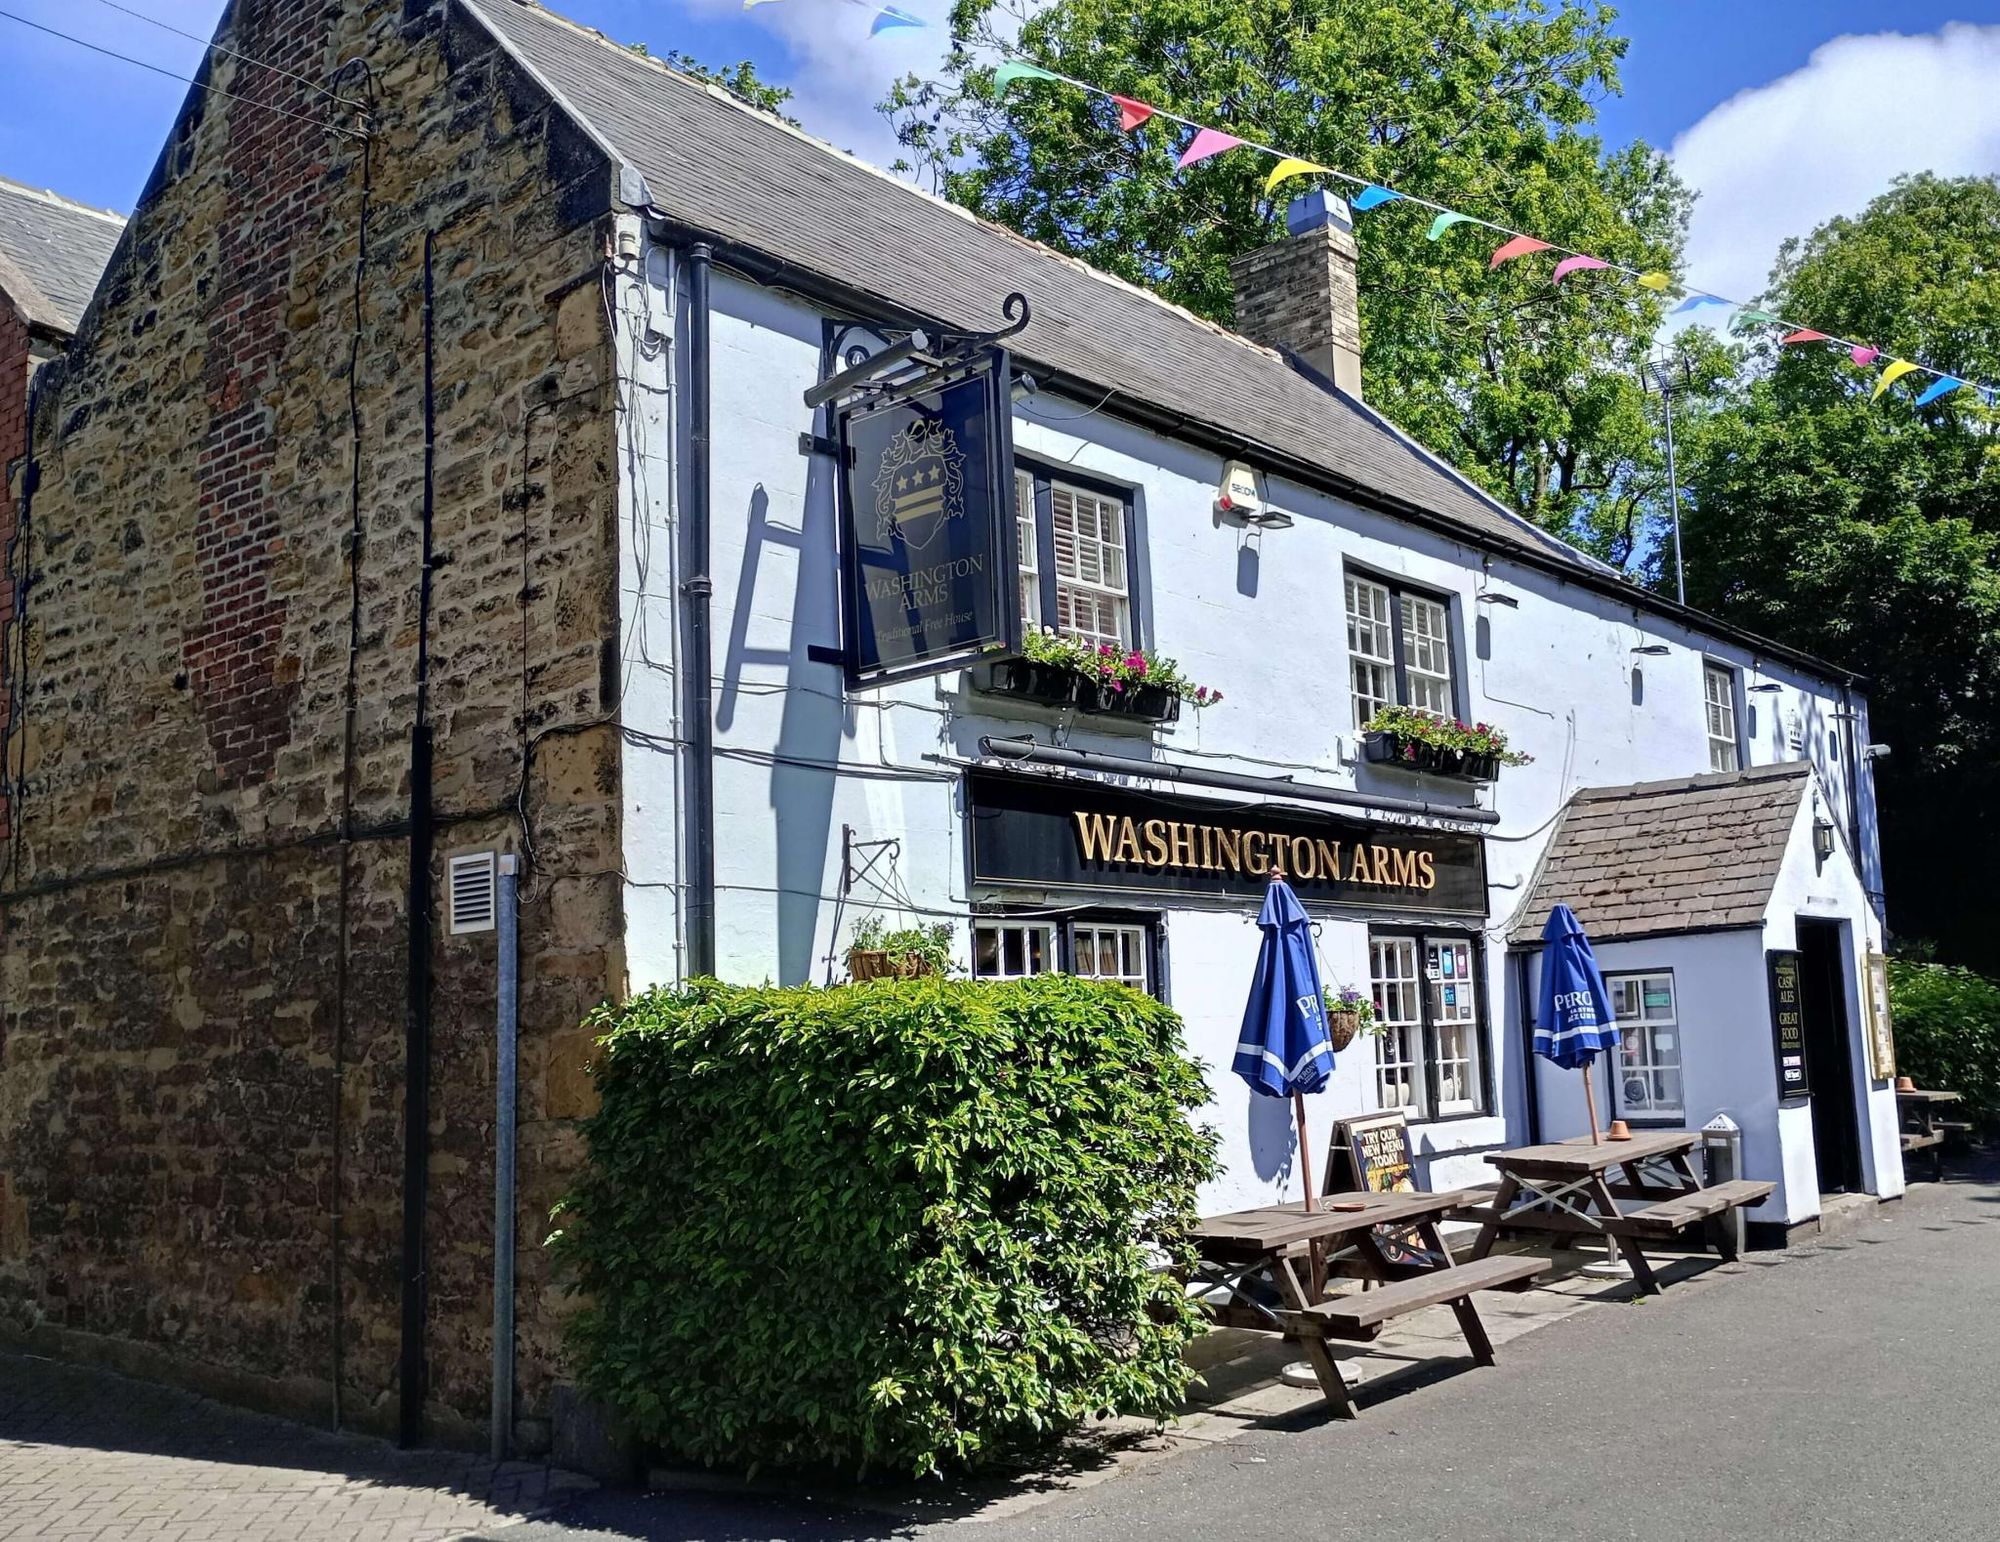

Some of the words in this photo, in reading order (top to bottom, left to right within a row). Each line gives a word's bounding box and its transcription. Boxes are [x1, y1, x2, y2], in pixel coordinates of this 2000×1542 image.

[864, 554, 983, 600] WASHINGTON
[899, 584, 948, 613] ARMS
[877, 621, 923, 641] Traditional
[924, 618, 944, 633] Free
[944, 611, 973, 627] House
[1072, 811, 1341, 881] WASHINGTON
[1349, 843, 1436, 890] ARMS
[1777, 976, 1794, 989] CASK
[1780, 990, 1795, 1003] ALES
[1779, 1012, 1798, 1025] GREAT
[1781, 1027, 1799, 1040] FOOD
[1363, 1131, 1379, 1145] TRY
[1380, 1128, 1398, 1141] OUR
[1361, 1143, 1380, 1159] NEW
[1381, 1138, 1405, 1153] MENU
[1372, 1151, 1398, 1168] TODAY
